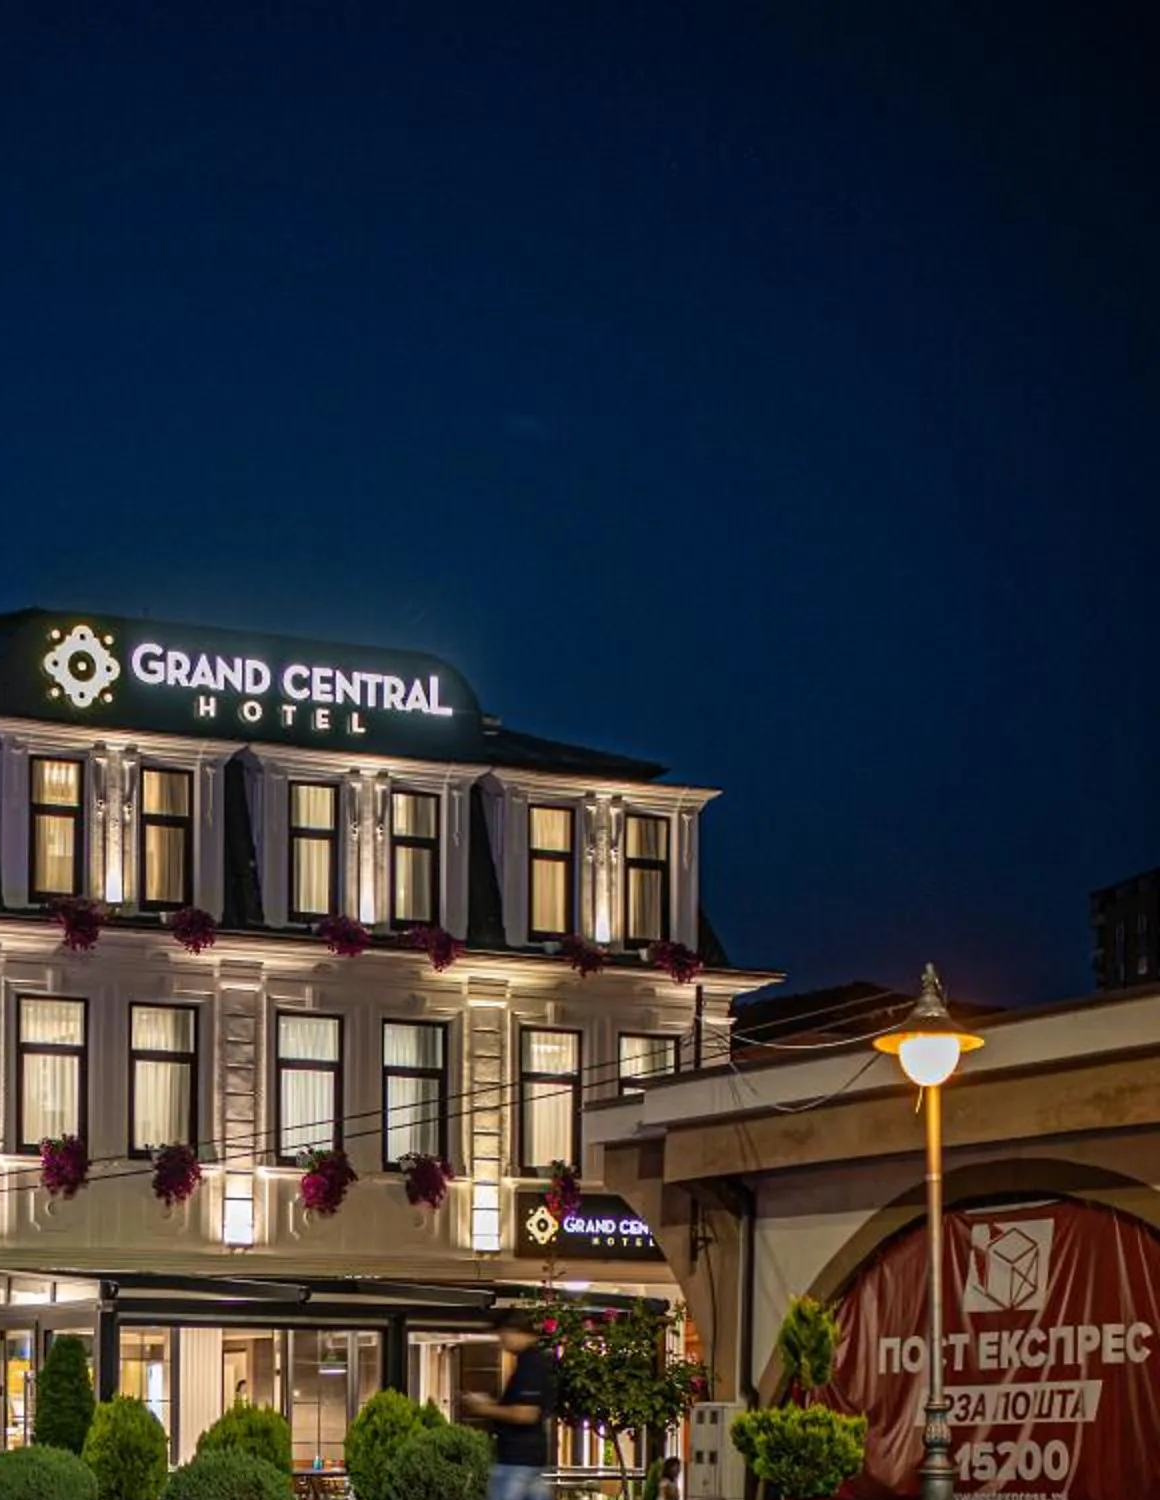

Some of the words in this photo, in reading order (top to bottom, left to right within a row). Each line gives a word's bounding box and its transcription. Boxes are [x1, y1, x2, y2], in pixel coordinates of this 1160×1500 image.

[131, 643, 271, 695] GRAND
[283, 665, 453, 717] CENTRAL
[194, 696, 366, 734] HOTEL
[563, 1216, 616, 1234] GRAND
[592, 1237, 655, 1247] HOTEL
[978, 1322, 1154, 1370] ЕКСПРЕС
[954, 1439, 1070, 1481] 15200
